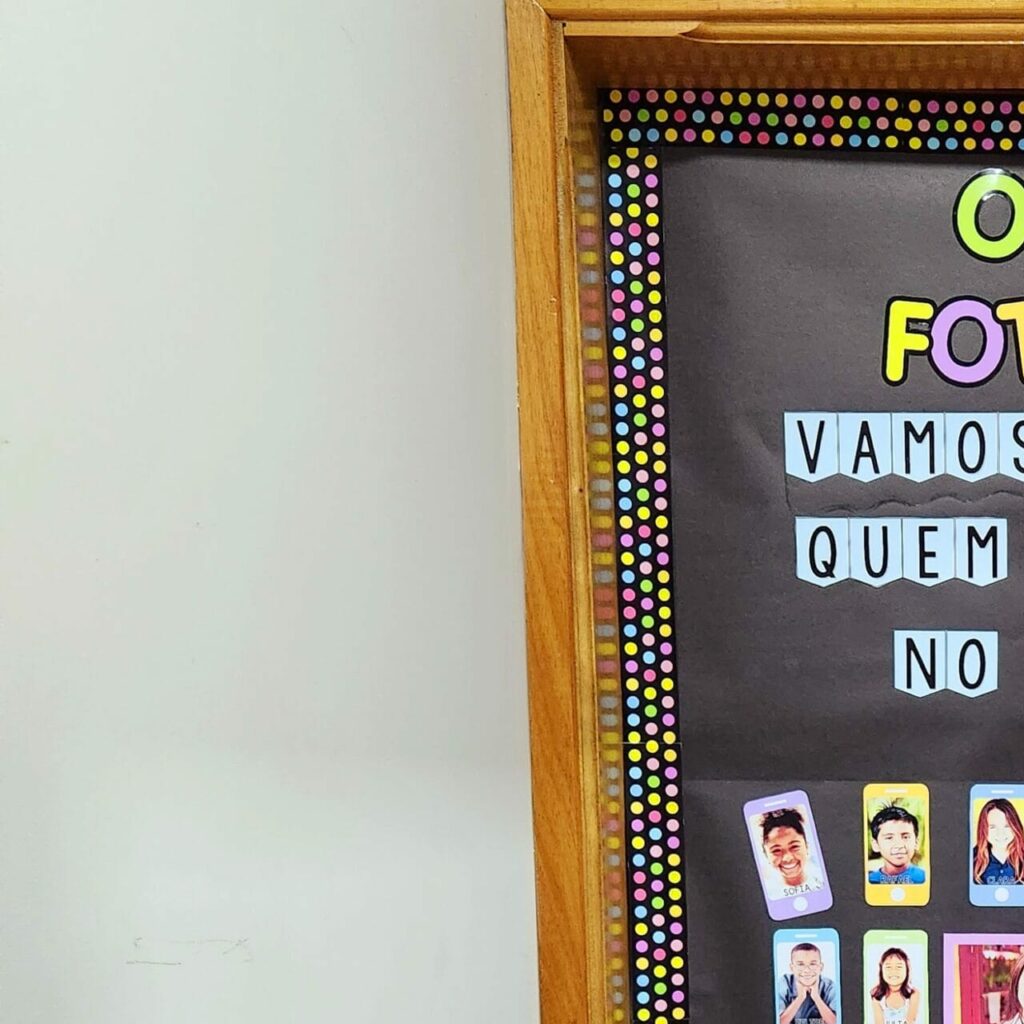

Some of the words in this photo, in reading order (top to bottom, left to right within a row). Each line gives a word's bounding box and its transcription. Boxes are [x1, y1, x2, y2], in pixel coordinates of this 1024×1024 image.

[808, 525, 999, 579] QUEM
[906, 637, 987, 691] NO
[783, 884, 812, 896] SOFIA
